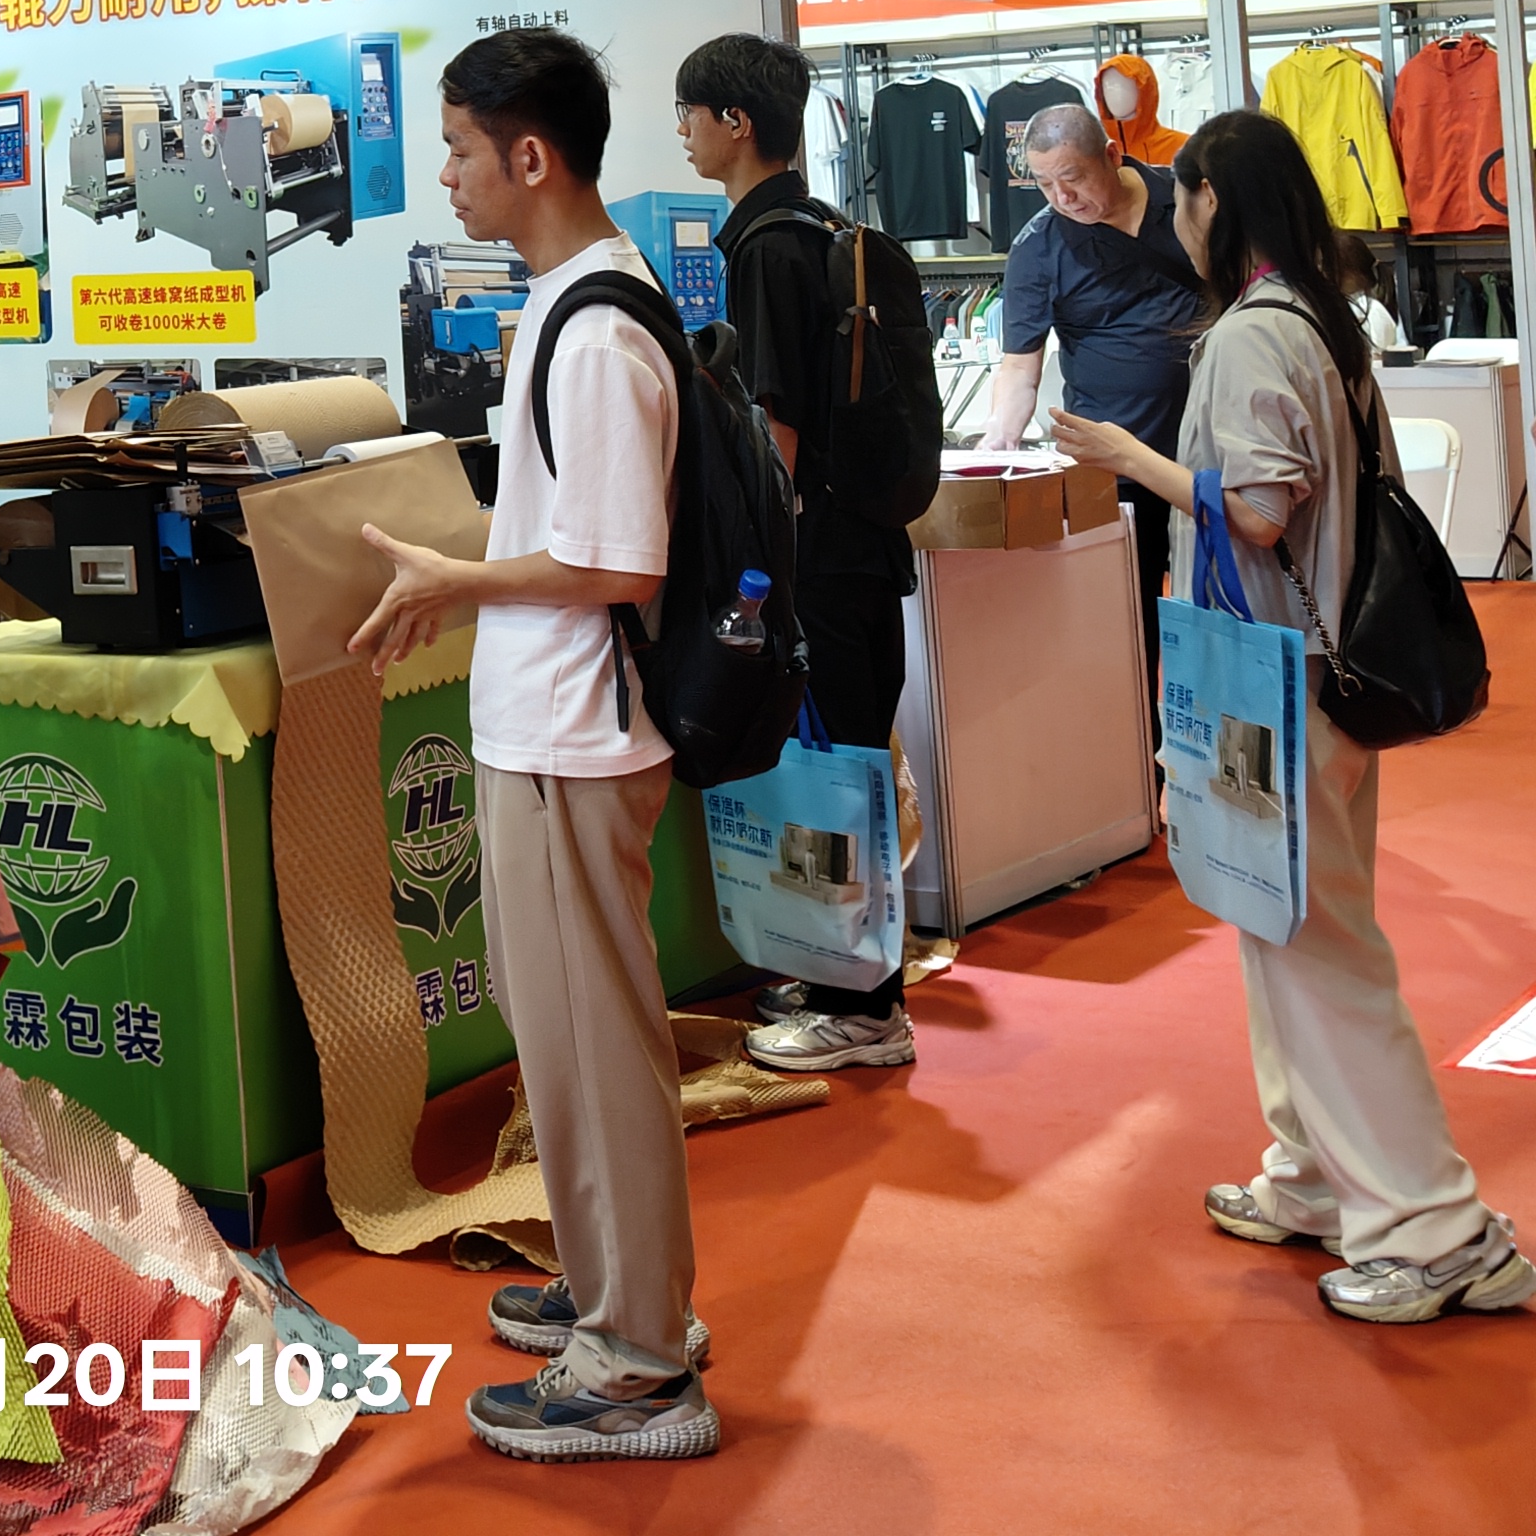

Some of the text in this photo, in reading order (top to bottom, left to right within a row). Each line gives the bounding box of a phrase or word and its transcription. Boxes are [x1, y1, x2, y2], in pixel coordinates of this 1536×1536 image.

[475, 9, 569, 33] 有轴自动上料
[79, 284, 247, 307] 第六代高速蜂窝纸成型机
[98, 311, 228, 333] 可收卷1000米大卷
[402, 775, 465, 837] HL
[415, 949, 497, 1031] 霖包
